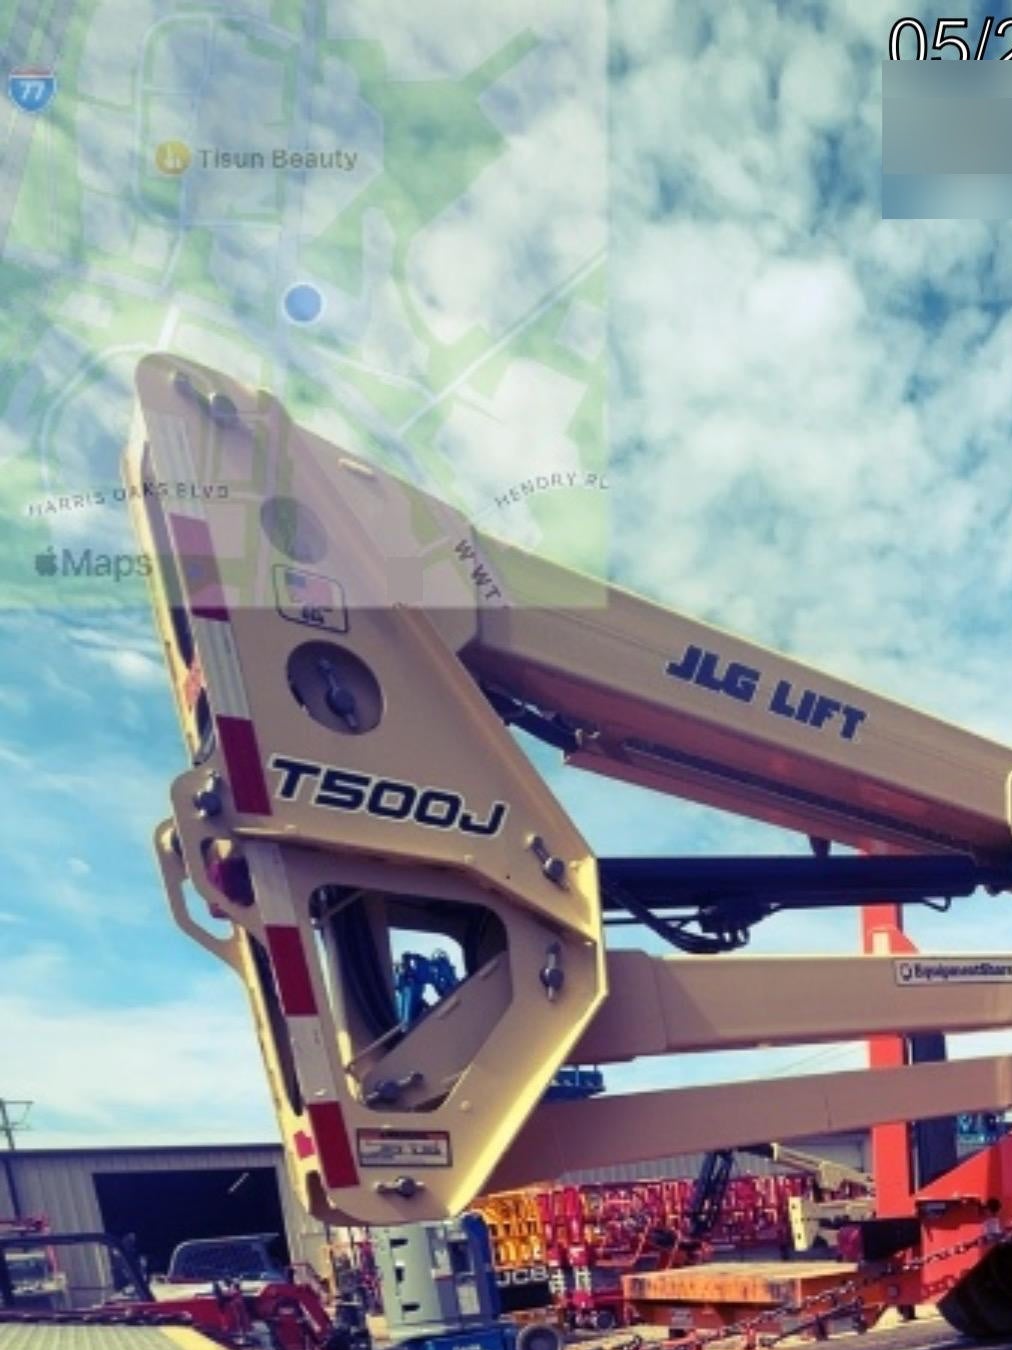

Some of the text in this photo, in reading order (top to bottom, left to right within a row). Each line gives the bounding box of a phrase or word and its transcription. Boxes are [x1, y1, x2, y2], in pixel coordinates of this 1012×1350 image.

[665, 644, 868, 741] JLG LIFT
[271, 757, 506, 836] T500J
[495, 1266, 549, 1288] JCB
